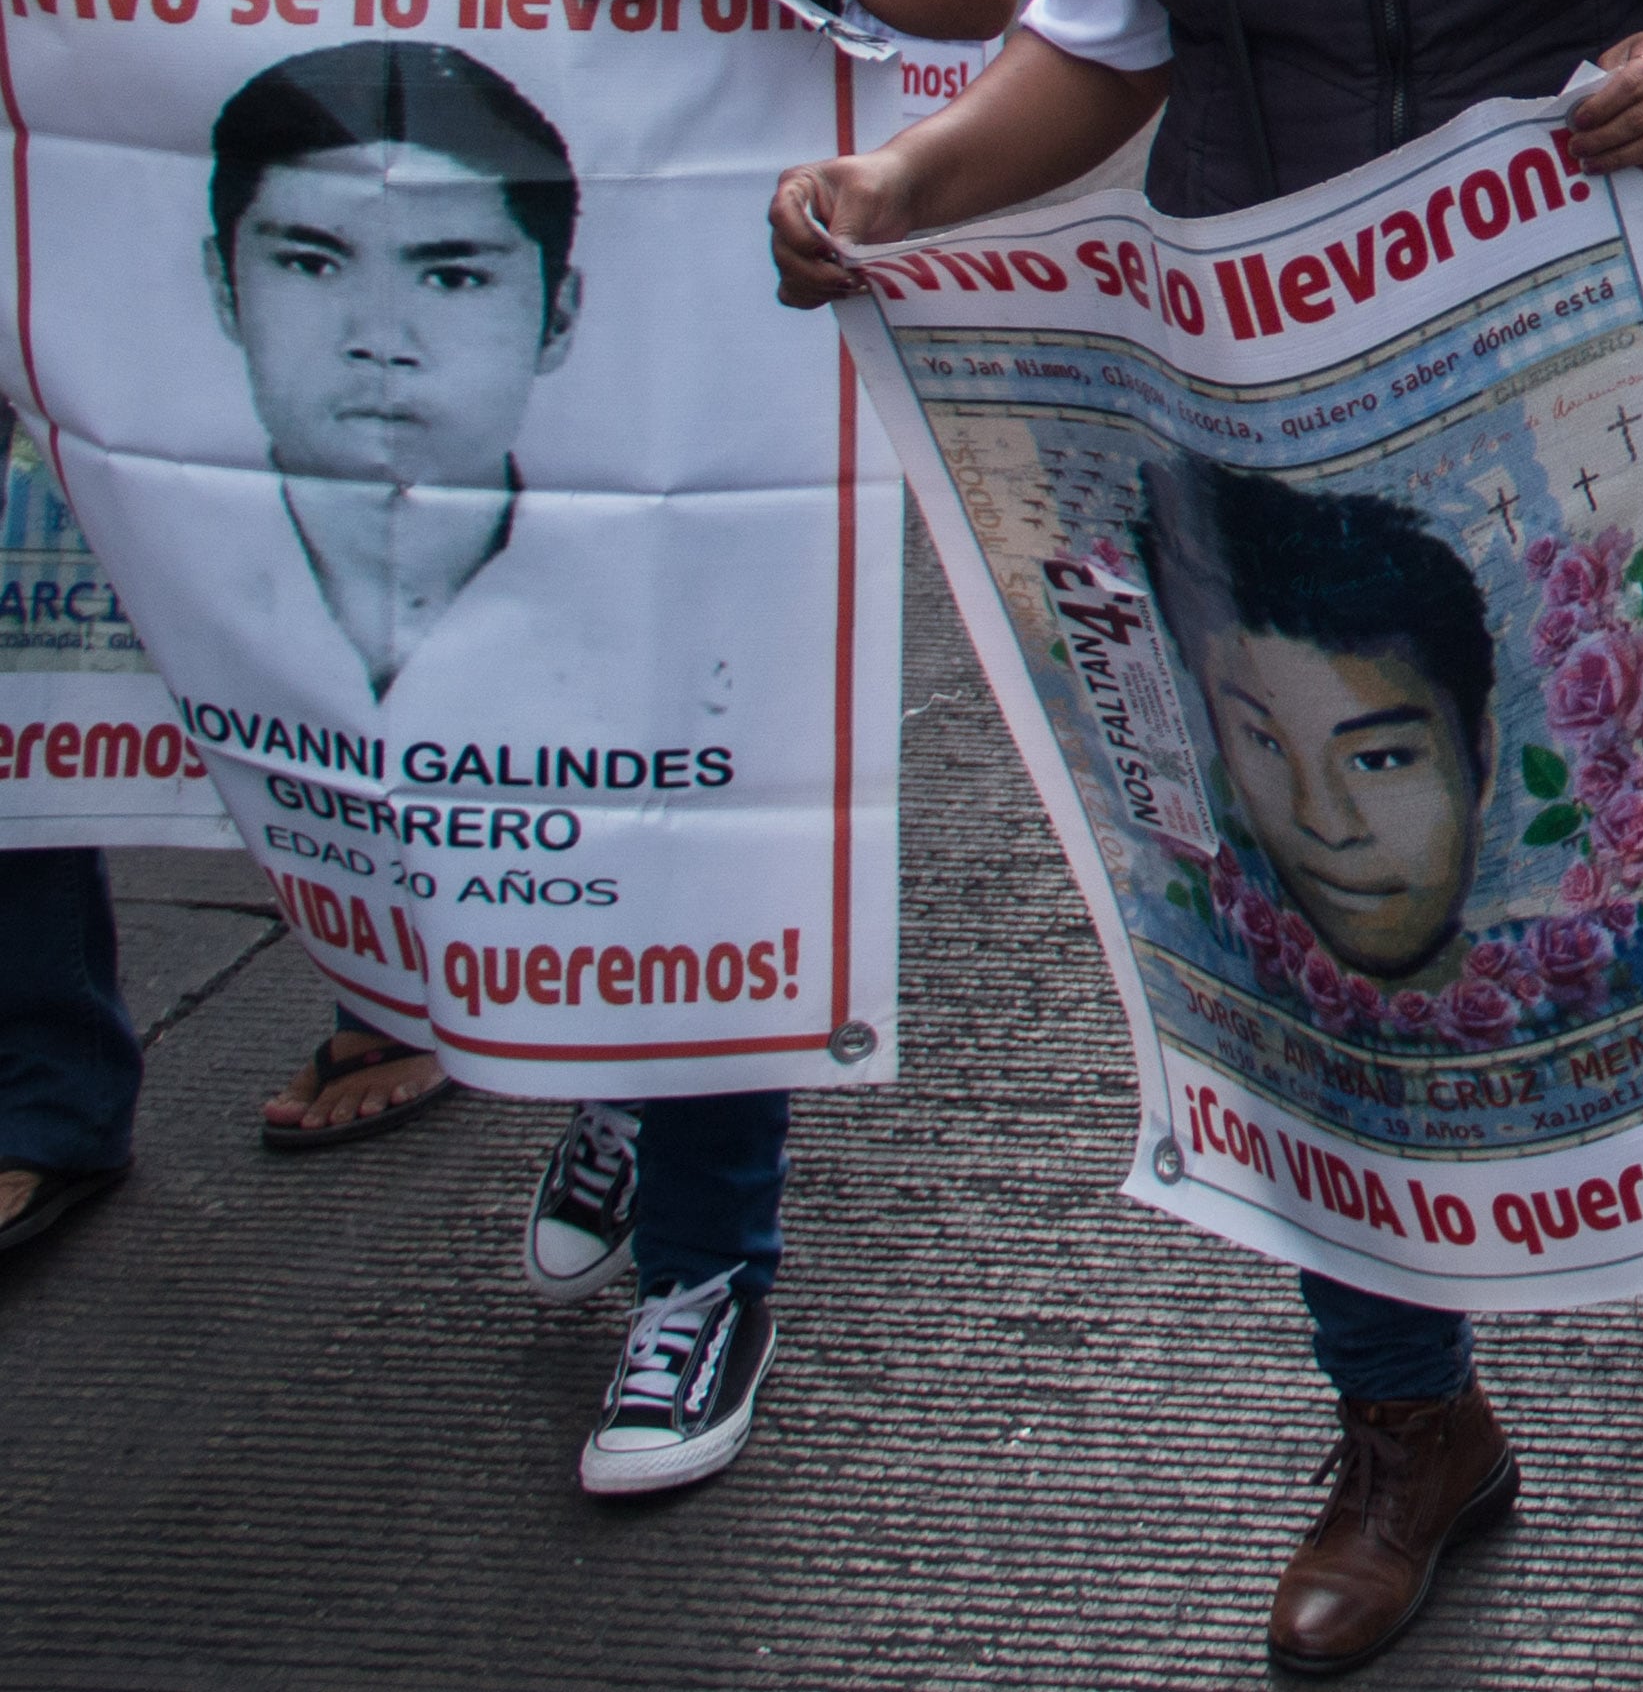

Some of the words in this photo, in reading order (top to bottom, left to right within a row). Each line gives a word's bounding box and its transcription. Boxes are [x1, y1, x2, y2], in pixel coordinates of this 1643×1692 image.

[1076, 238, 1150, 299] se
[1152, 240, 1206, 338] lo
[1212, 127, 1594, 342] llevaron!
[922, 356, 954, 378] Yo
[960, 356, 1006, 379] Jan
[1014, 356, 1093, 388] Nimmo,
[1280, 389, 1379, 440] quiero
[1390, 350, 1460, 399] saber
[1472, 309, 1543, 358] dónde
[1551, 274, 1617, 321] está
[1070, 633, 1143, 751] FALTAN
[178, 694, 386, 781] IOVANNI
[402, 740, 735, 789] GALINDES
[266, 774, 582, 851] GUERRERO
[1115, 756, 1164, 827] NOS
[264, 823, 378, 879] EDAD
[456, 870, 619, 910] AÑOS
[444, 927, 802, 1019] queremos!
[1184, 985, 1264, 1051] JORGE
[1426, 1070, 1547, 1116] CRUZ
[1184, 1082, 1275, 1175] ¡Con
[1277, 1126, 1409, 1242] VIDA
[1410, 1178, 1478, 1249] lo
[1423, 1114, 1486, 1142] Años
